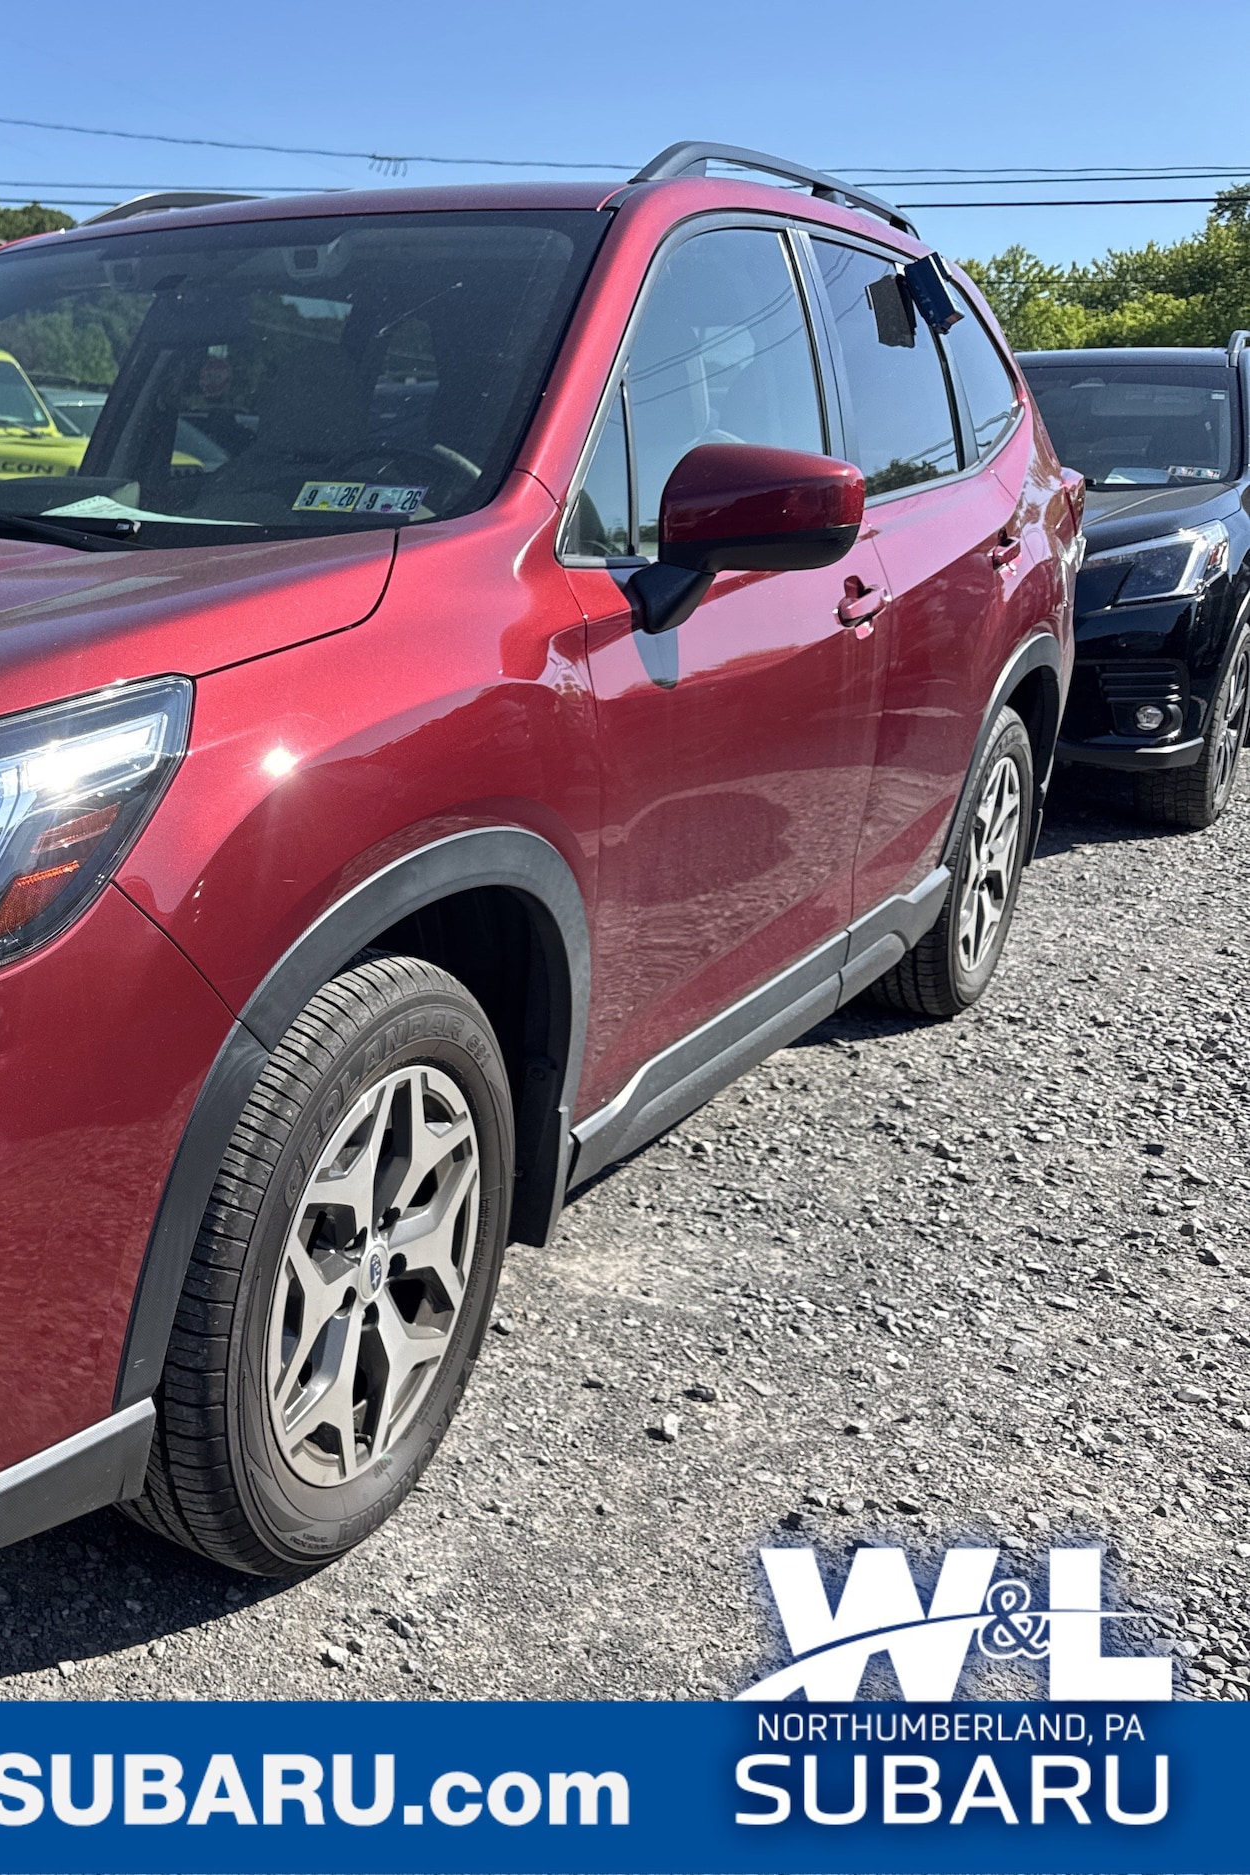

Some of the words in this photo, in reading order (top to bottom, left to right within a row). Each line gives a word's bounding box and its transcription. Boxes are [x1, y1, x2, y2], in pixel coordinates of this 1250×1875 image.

[304, 489, 319, 507] 9
[337, 486, 360, 507] 26
[365, 492, 380, 510] 9
[400, 490, 422, 510] 26
[285, 1010, 464, 1208] GEOLANDAR
